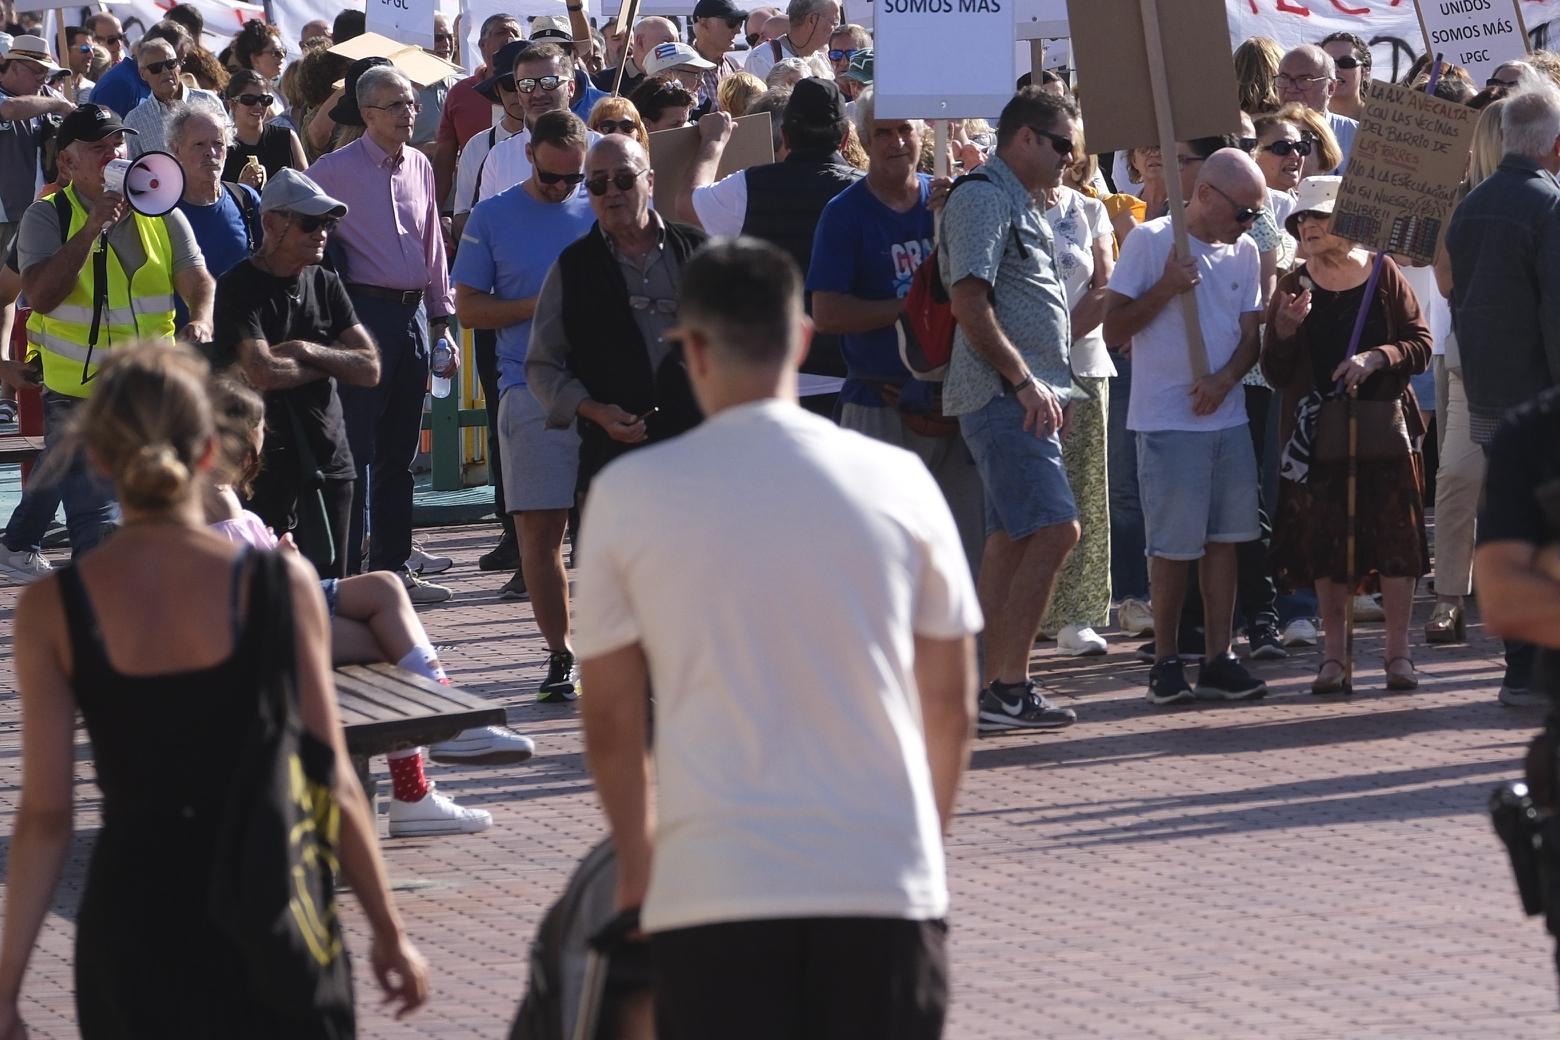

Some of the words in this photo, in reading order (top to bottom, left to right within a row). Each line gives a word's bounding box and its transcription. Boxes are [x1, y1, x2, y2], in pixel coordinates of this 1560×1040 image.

[1431, 23, 1481, 44] SOMOS
[1482, 17, 1513, 37] MÁS
[1460, 49, 1491, 65] LPGC
[1360, 119, 1384, 137] DEL
[1431, 140, 1453, 154] DE
[1391, 110, 1413, 126] LAS
[1414, 113, 1460, 138] VECINAS
[1366, 165, 1375, 181] A
[1377, 170, 1390, 184] LA
